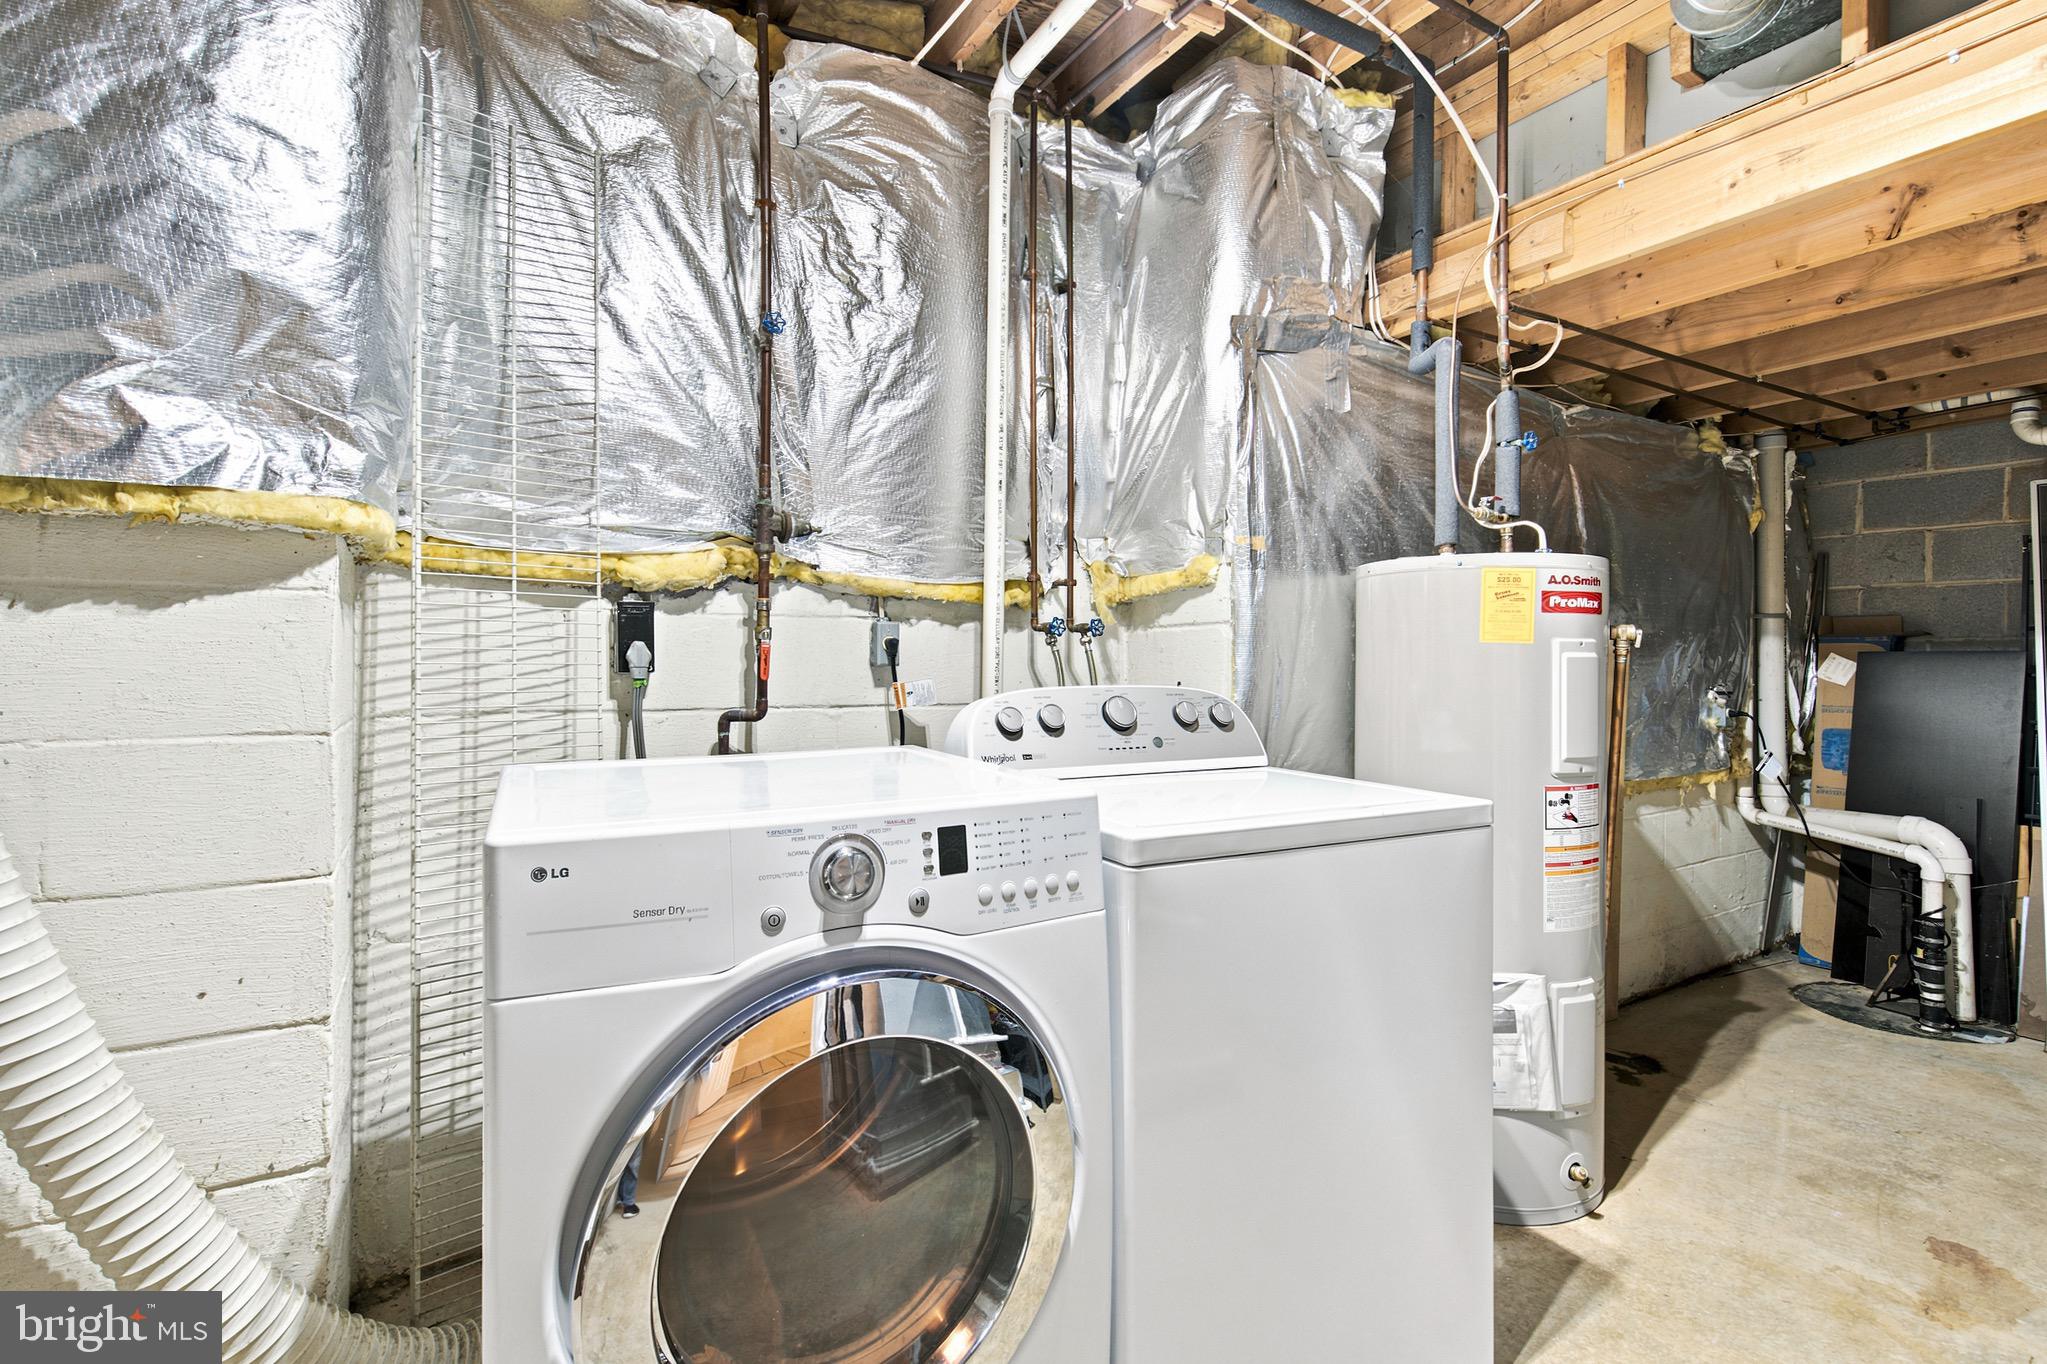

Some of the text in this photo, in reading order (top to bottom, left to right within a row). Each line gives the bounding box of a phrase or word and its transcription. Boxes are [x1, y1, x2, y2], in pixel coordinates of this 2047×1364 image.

[1549, 595, 1599, 608] ProMax
[980, 753, 1016, 766] Whirlpool
[551, 868, 570, 878] LG
[632, 907, 666, 919] Sensor
[668, 905, 686, 916] Dry
